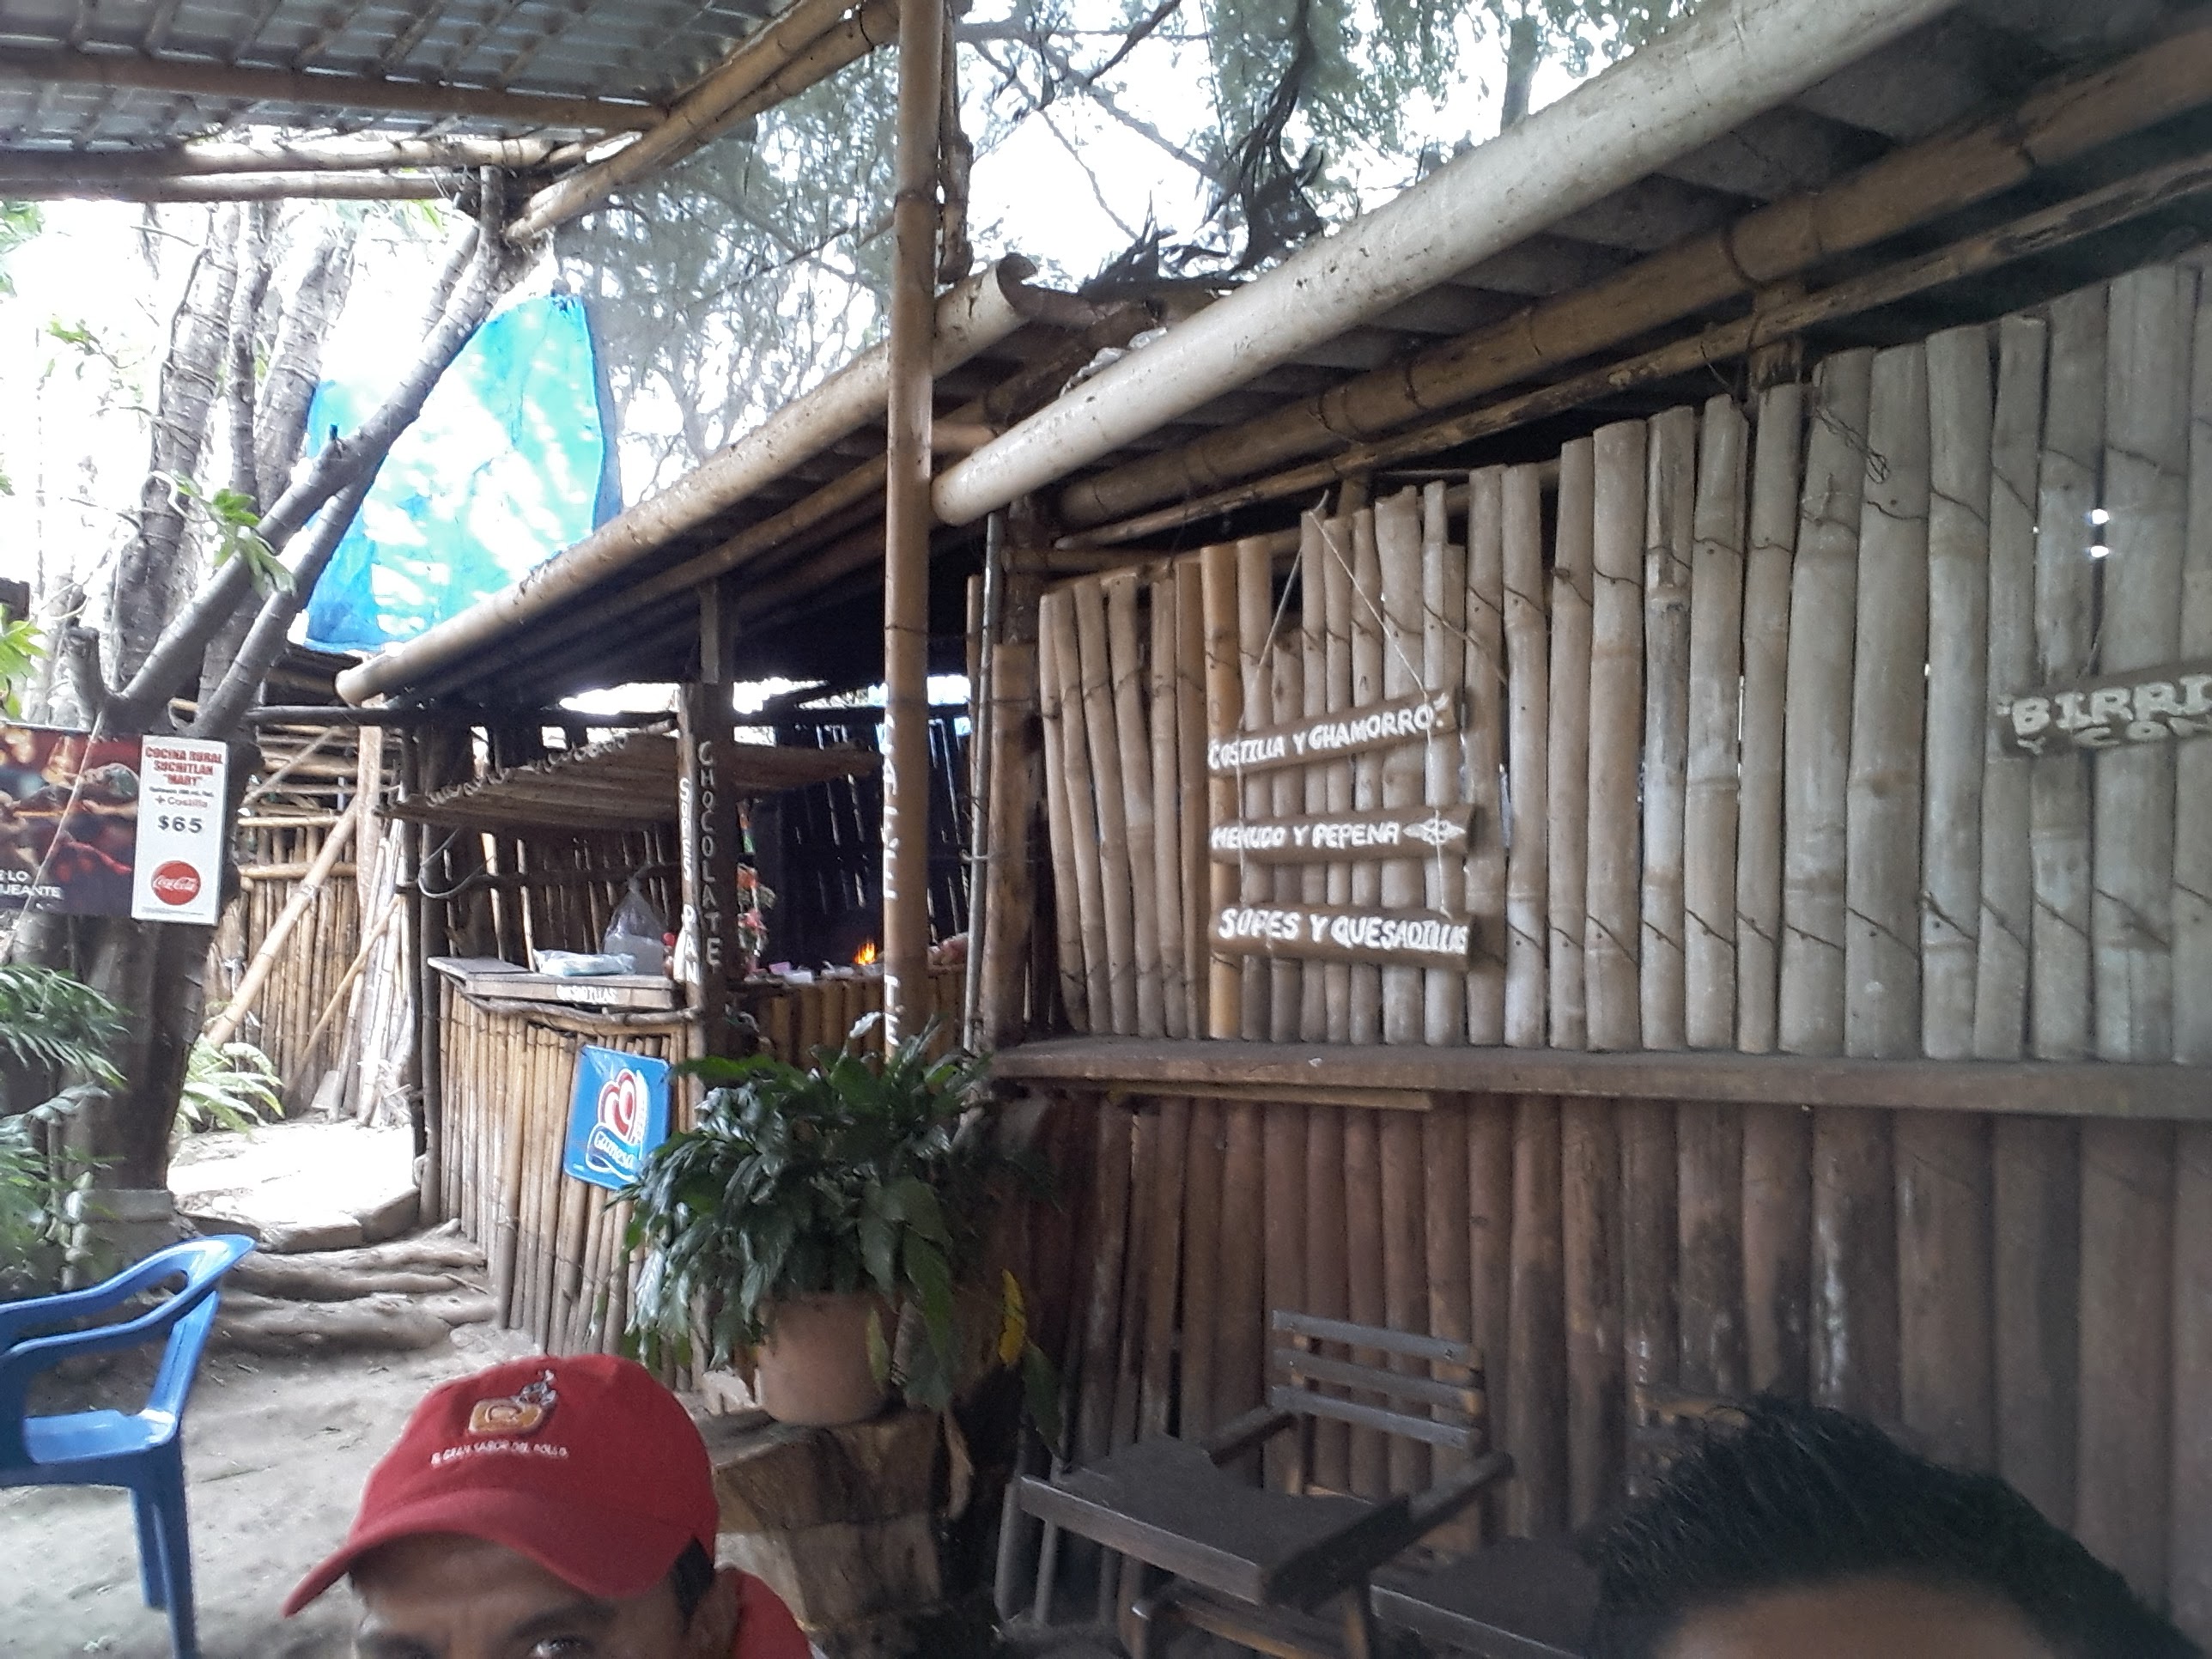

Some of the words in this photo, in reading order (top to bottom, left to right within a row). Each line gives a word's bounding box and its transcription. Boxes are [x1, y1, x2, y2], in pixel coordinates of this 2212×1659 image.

[1208, 736, 1285, 769] COSTILLA
[1292, 732, 1306, 755] Y
[158, 815, 203, 834] $65
[1293, 825, 1310, 846] Y
[1312, 822, 1400, 848] PEPENA
[697, 740, 721, 967] CHOCOLATE
[1218, 908, 1301, 940] SOPES
[1310, 914, 1328, 943] Y
[683, 903, 700, 986] PAN
